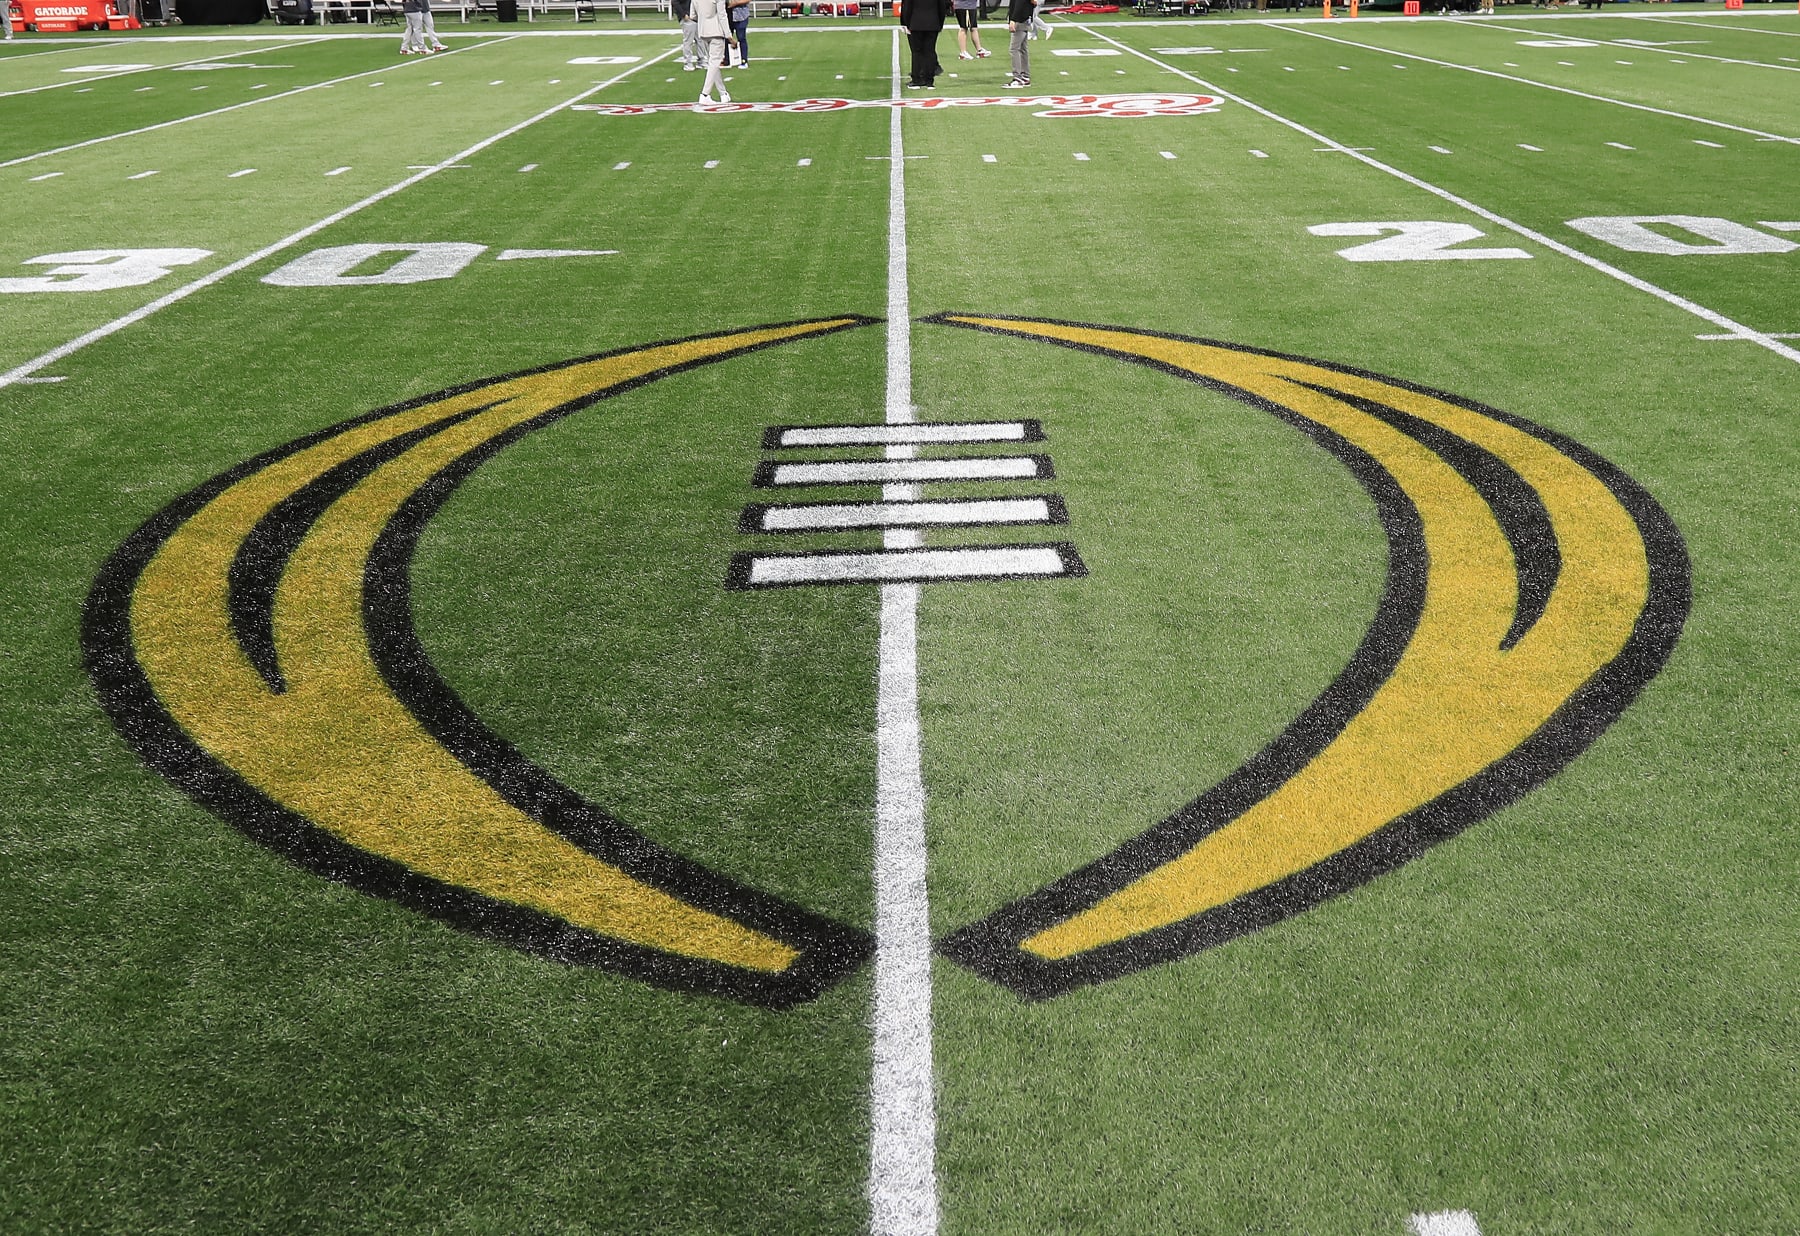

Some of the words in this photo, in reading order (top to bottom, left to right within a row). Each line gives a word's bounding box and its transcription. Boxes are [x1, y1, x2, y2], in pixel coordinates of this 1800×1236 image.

[34, 6, 88, 17] GATORADE
[105, 3, 111, 16] G
[1407, 3, 1417, 13] 10
